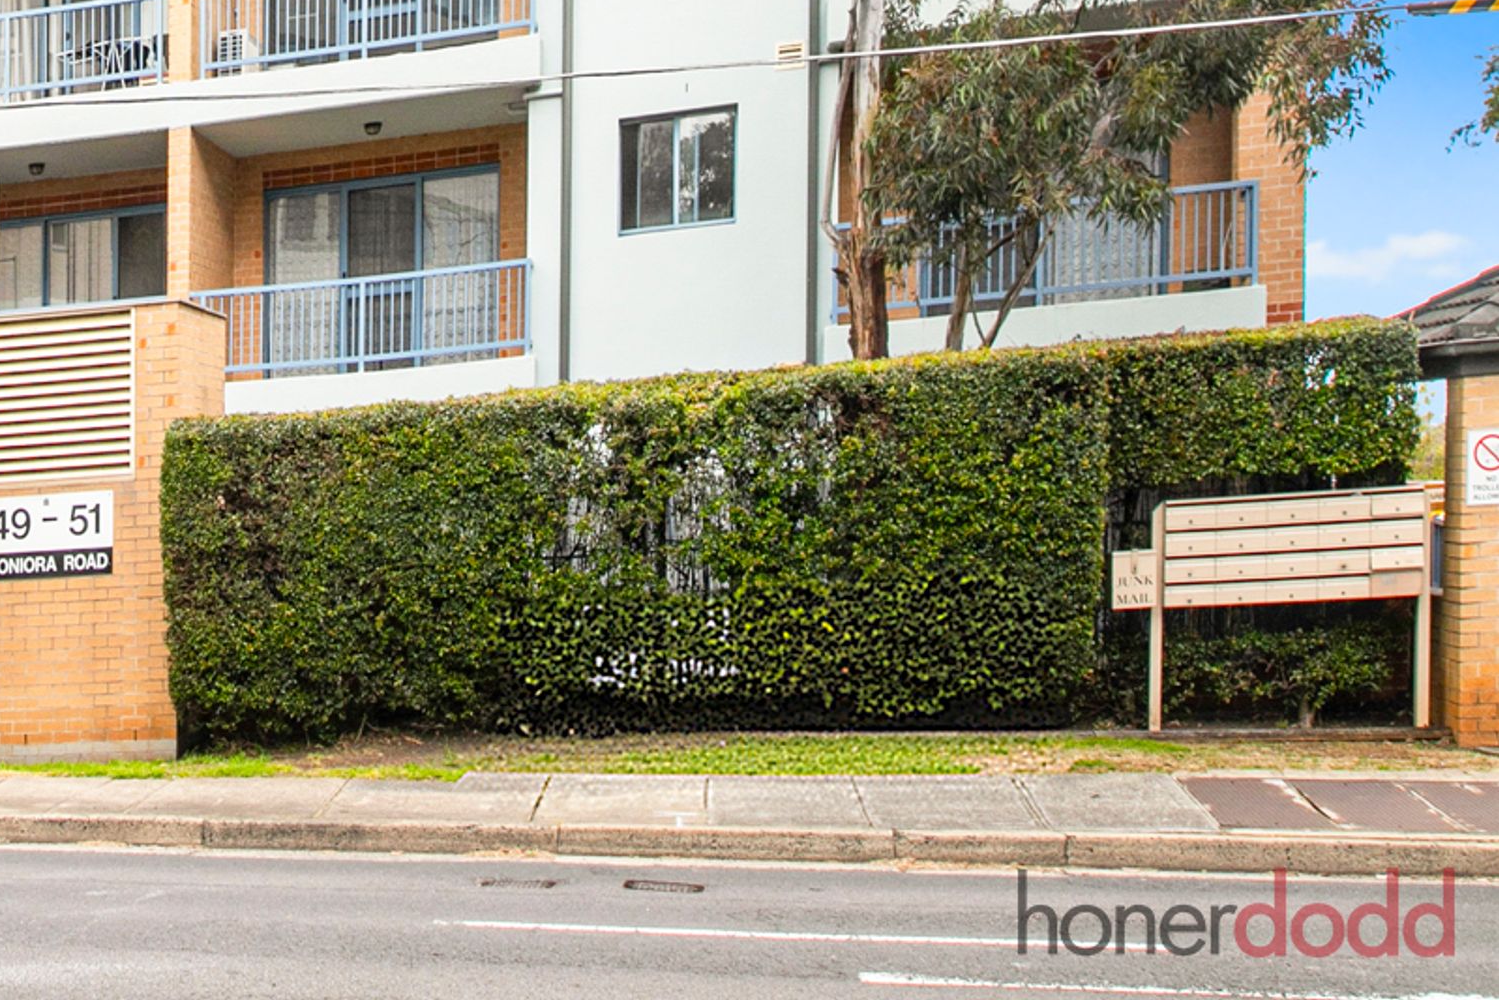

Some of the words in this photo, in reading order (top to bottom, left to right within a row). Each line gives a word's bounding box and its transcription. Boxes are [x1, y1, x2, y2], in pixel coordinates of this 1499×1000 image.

[69, 503, 100, 535] 51
[63, 552, 108, 571] ROAD
[1117, 576, 1154, 587] JUNK
[1116, 593, 1153, 605] MAIL
